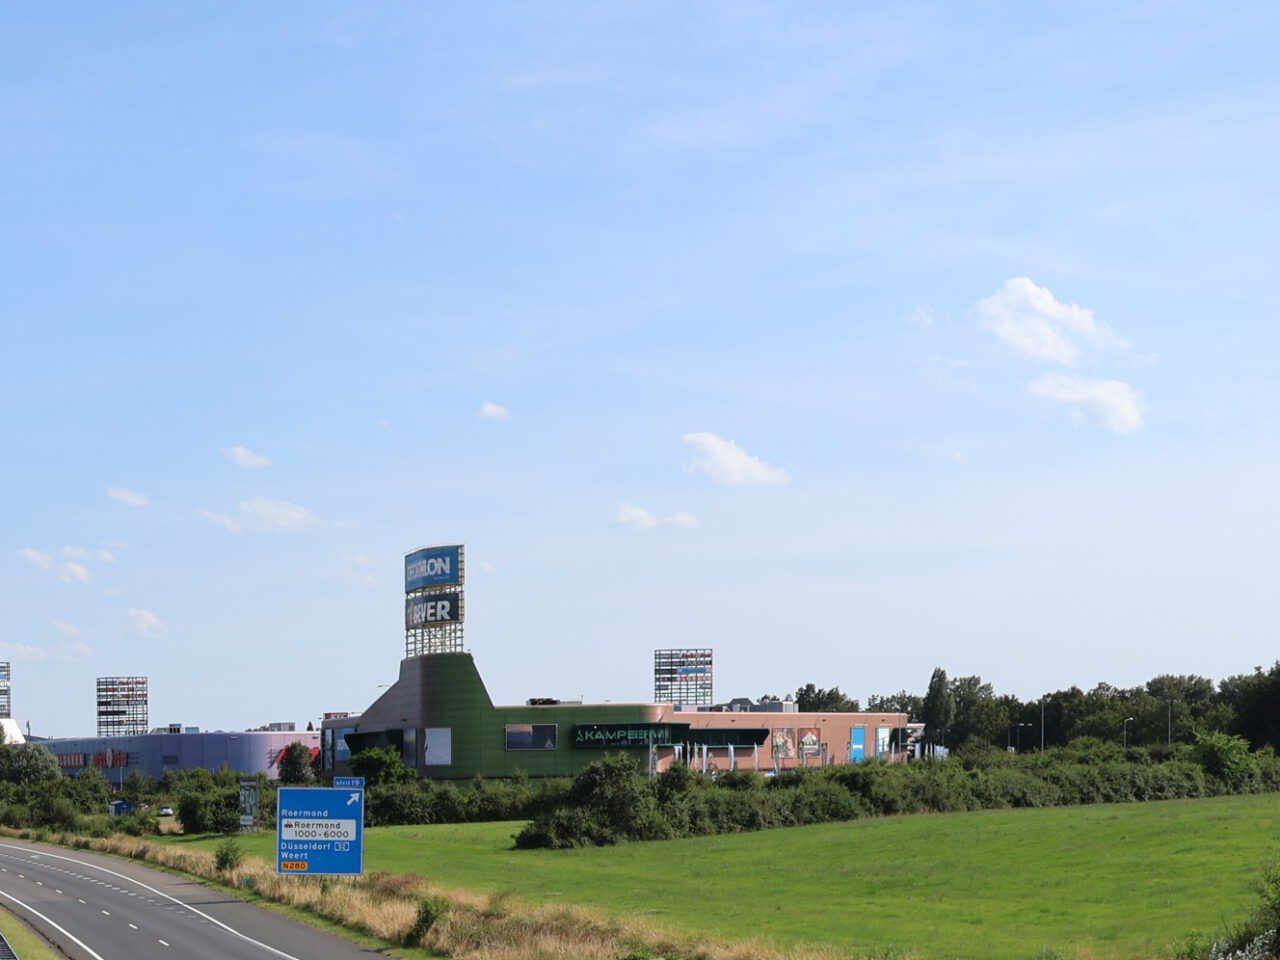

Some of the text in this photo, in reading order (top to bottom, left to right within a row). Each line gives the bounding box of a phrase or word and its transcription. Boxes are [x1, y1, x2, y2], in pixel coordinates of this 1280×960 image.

[281, 809, 328, 817] Roermond
[294, 821, 341, 829] Roermond
[281, 842, 331, 850] Düsseldorf
